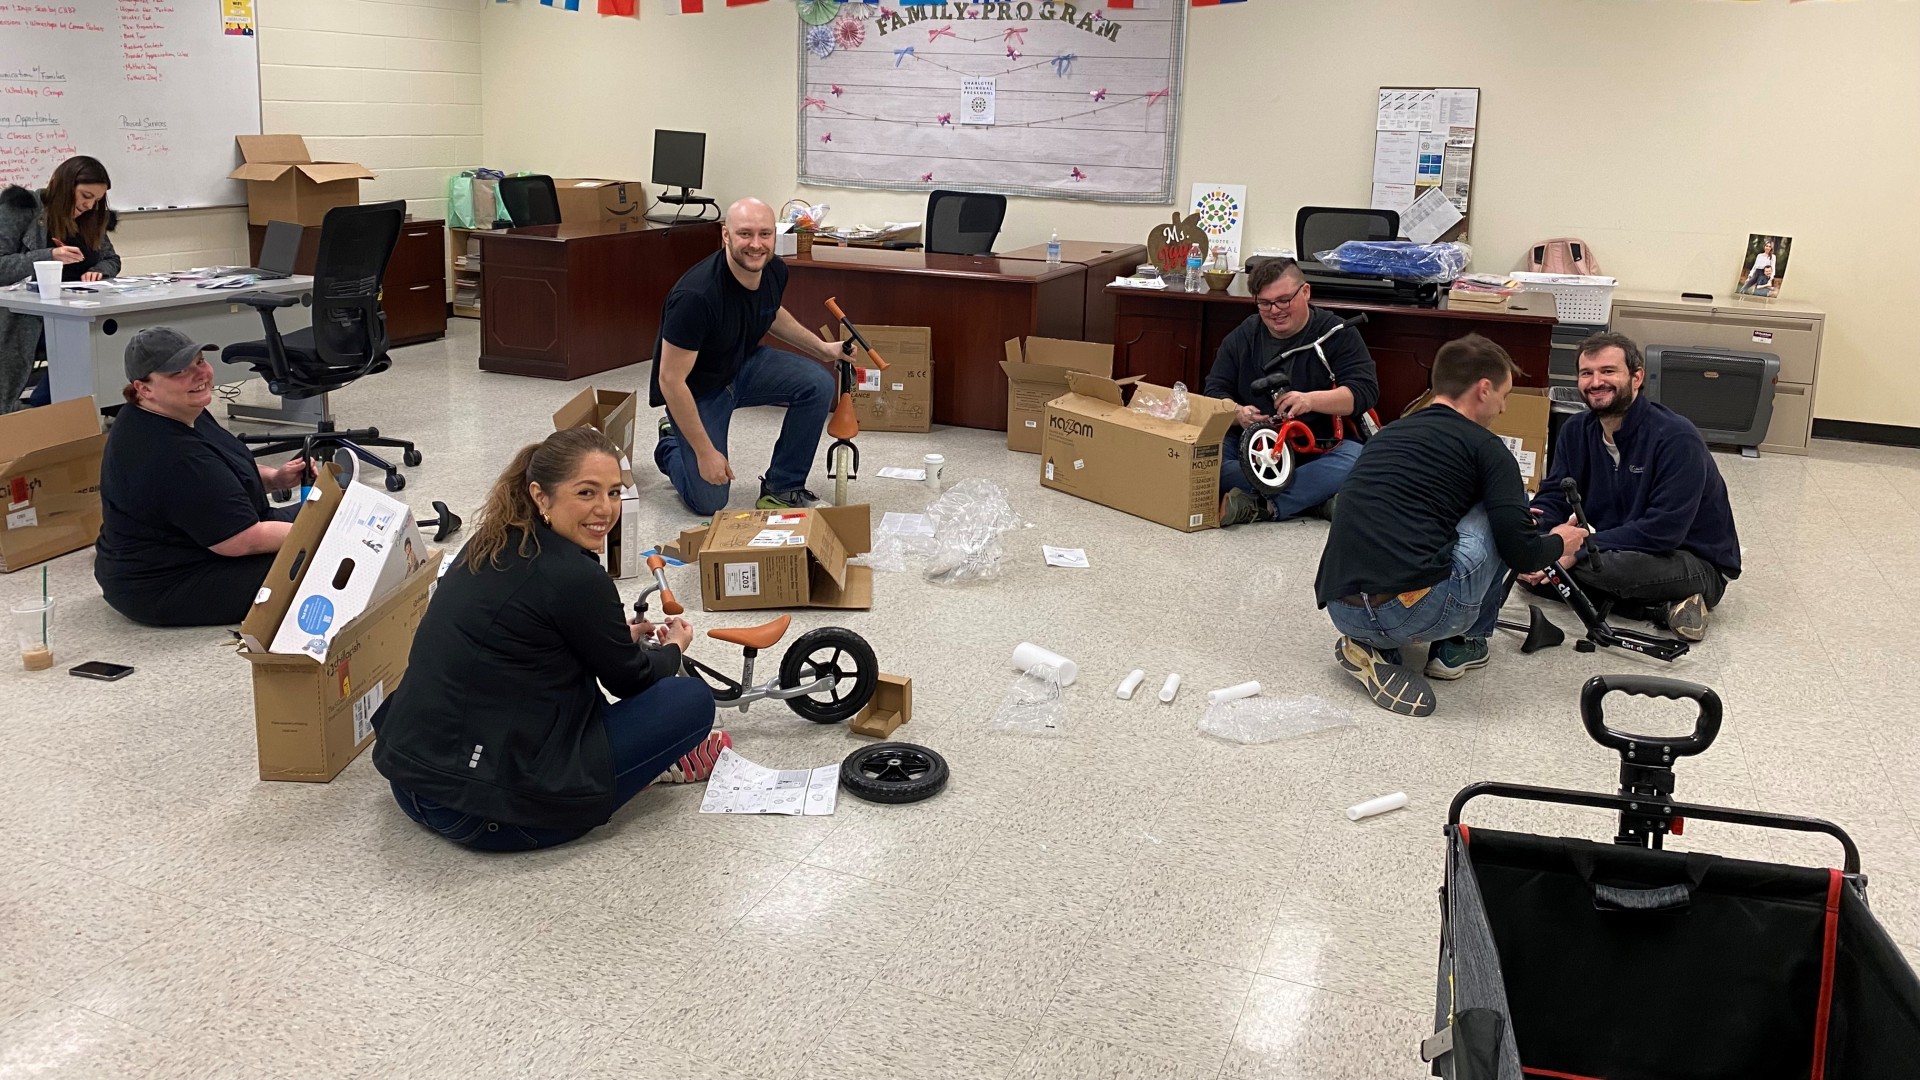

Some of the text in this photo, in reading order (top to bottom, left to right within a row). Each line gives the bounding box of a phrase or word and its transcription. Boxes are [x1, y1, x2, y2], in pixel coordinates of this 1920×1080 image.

[875, 2, 1122, 42] FAMILY PROGRAM
[41, 71, 66, 79] Families
[7, 132, 32, 140] Classes
[1163, 225, 1190, 244] Ms.
[1167, 447, 1180, 459] 3+
[624, 522, 634, 567] chillafish
